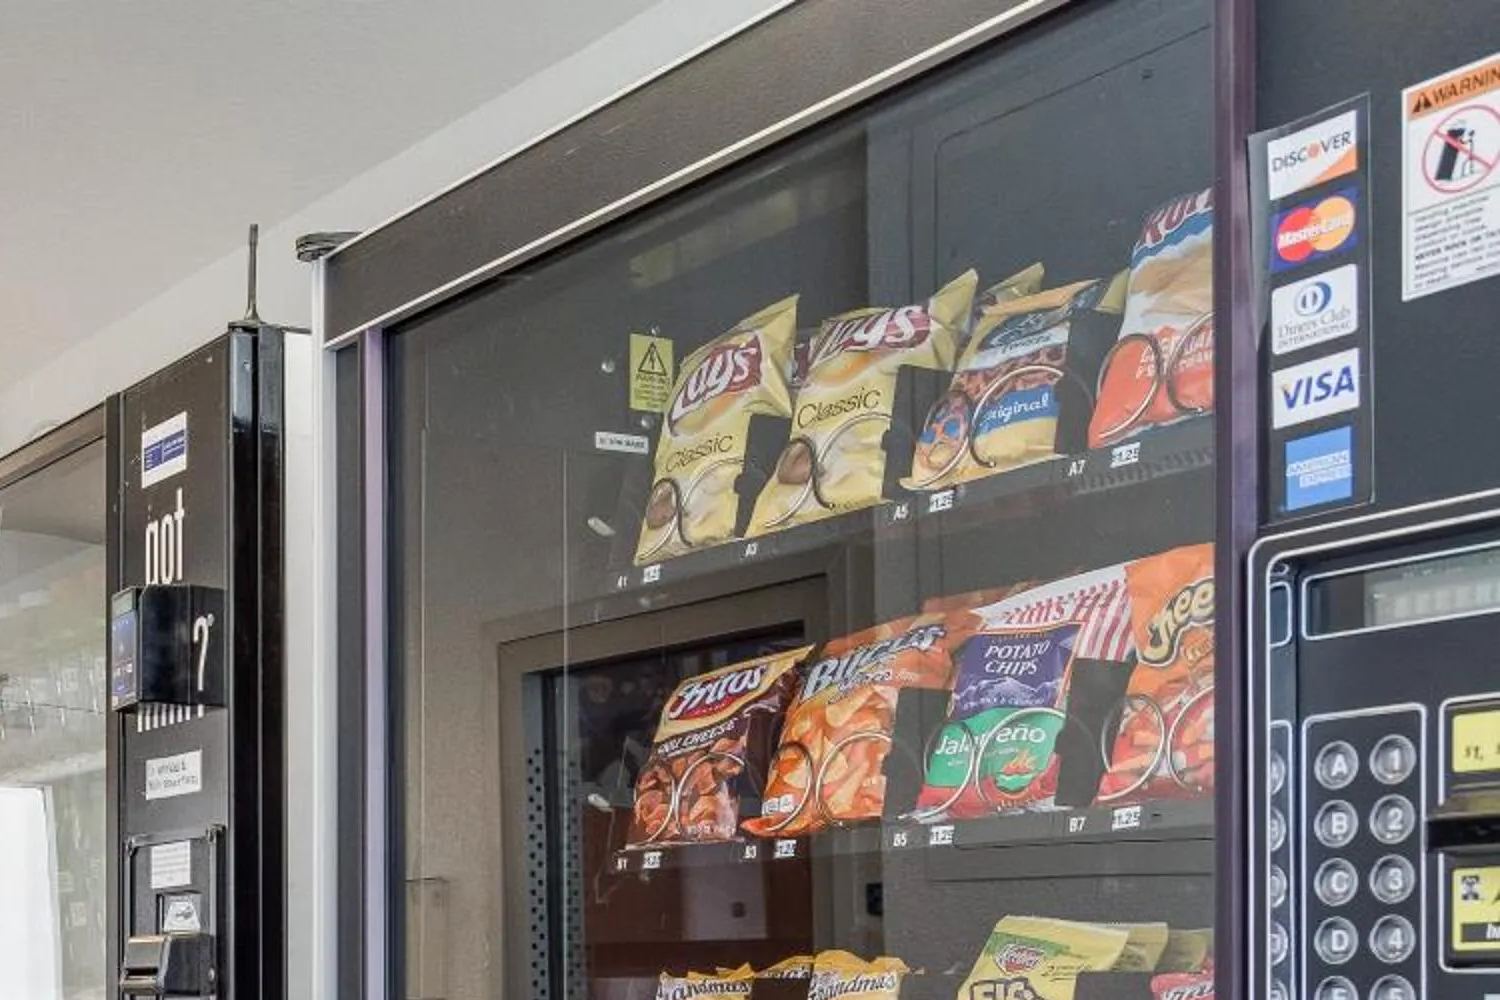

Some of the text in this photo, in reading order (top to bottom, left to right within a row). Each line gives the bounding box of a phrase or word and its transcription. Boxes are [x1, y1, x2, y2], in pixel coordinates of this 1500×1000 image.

[1272, 131, 1351, 172] DISCOVER
[1282, 365, 1356, 410] VISA
[797, 385, 882, 429] Classic
[665, 434, 733, 473] Classic
[1068, 460, 1086, 477] A7
[984, 639, 1050, 659] POTATO
[985, 658, 1038, 677] CHIPS
[668, 664, 767, 719] Fritos
[1331, 755, 1348, 778] A
[1069, 816, 1087, 833] B7
[1332, 808, 1404, 836] B 2
[1331, 867, 1403, 894] C 3
[1331, 929, 1403, 953] D 4
